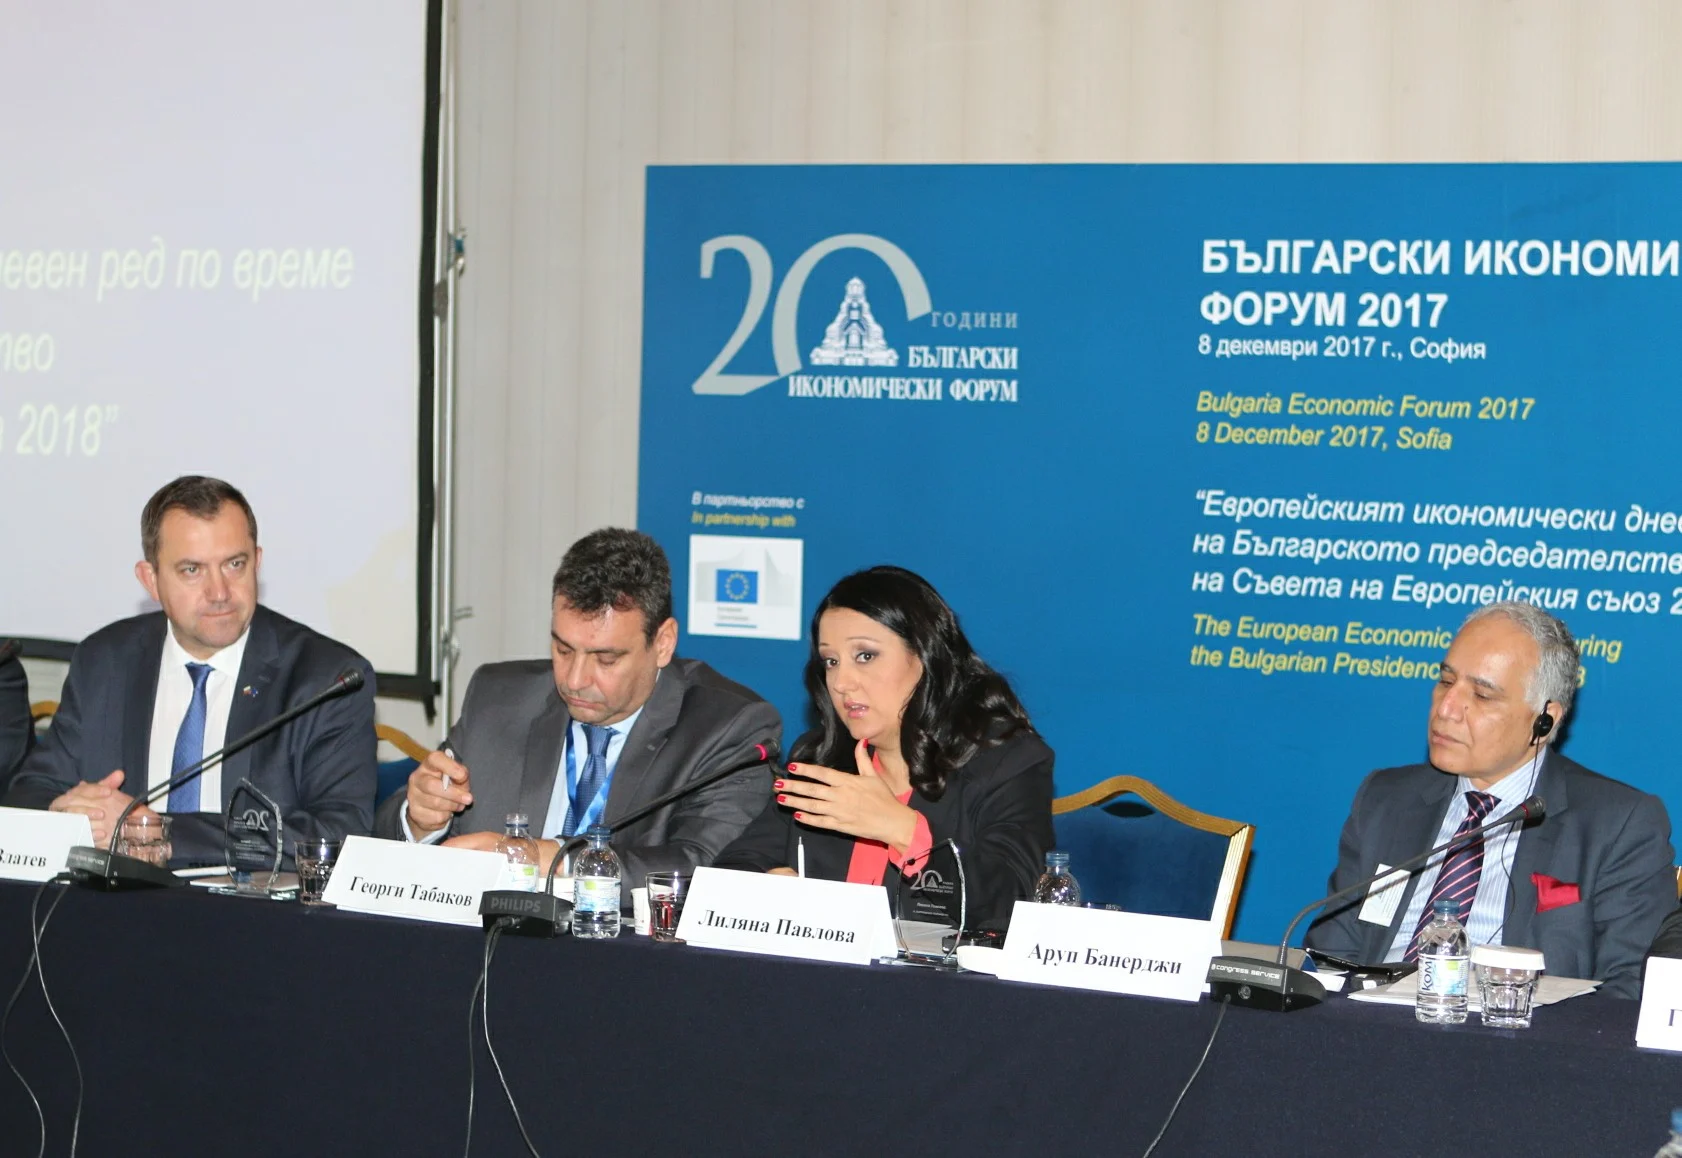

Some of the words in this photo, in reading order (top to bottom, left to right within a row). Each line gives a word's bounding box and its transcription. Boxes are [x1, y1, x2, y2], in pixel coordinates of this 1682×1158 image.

[0, 249, 89, 290] евен
[97, 235, 166, 303] ред
[175, 247, 221, 289] по
[232, 247, 355, 303] време
[1202, 239, 1451, 275] БЪЛГАРСКИ
[1464, 239, 1680, 277] ИКОНОМИ
[1200, 291, 1346, 327] ФОРУМ
[1357, 293, 1449, 328] 2017
[908, 345, 1018, 370] БЪЛГАРСКИ
[1198, 334, 1212, 355] 8
[1215, 338, 1318, 360] декември
[1323, 335, 1376, 357] 2017
[1409, 337, 1487, 364] София
[788, 374, 943, 401] ИКОНОМИЧЕСКИ
[949, 378, 1018, 403] ФОРУМ
[1196, 391, 1283, 416] Bulgaria
[1287, 393, 1395, 417] Economic
[1399, 395, 1472, 419] Forum
[1477, 397, 1536, 420] 2017
[1195, 422, 1211, 444] 8
[1214, 422, 1325, 447] December
[1329, 425, 1388, 450] 2017,
[1396, 427, 1453, 450] Sofia
[704, 513, 771, 529] partnership
[771, 514, 797, 528] with
[1412, 504, 1617, 532] икономически
[1624, 504, 1682, 534] дне
[1192, 533, 1226, 555] на
[1232, 529, 1421, 565] Българското
[1191, 571, 1225, 593] на
[1232, 567, 1343, 598] Съвета
[1349, 578, 1384, 601] на
[1391, 574, 1579, 610] Европейския
[1586, 589, 1661, 614] съюз
[1193, 613, 1232, 637] The
[1237, 616, 1339, 644] European
[1344, 621, 1452, 650] Economic
[1190, 645, 1224, 667] the
[1228, 647, 1328, 676] Bulgarian
[1333, 653, 1441, 681] Presidenc
[349, 876, 405, 901] Георги
[410, 884, 473, 907] Табаков
[490, 897, 541, 913] PHILIPS
[697, 910, 770, 933] Лиляна
[776, 918, 855, 944] Павлова
[1027, 942, 1078, 967] Аруп
[1084, 947, 1182, 975] Банерджи
